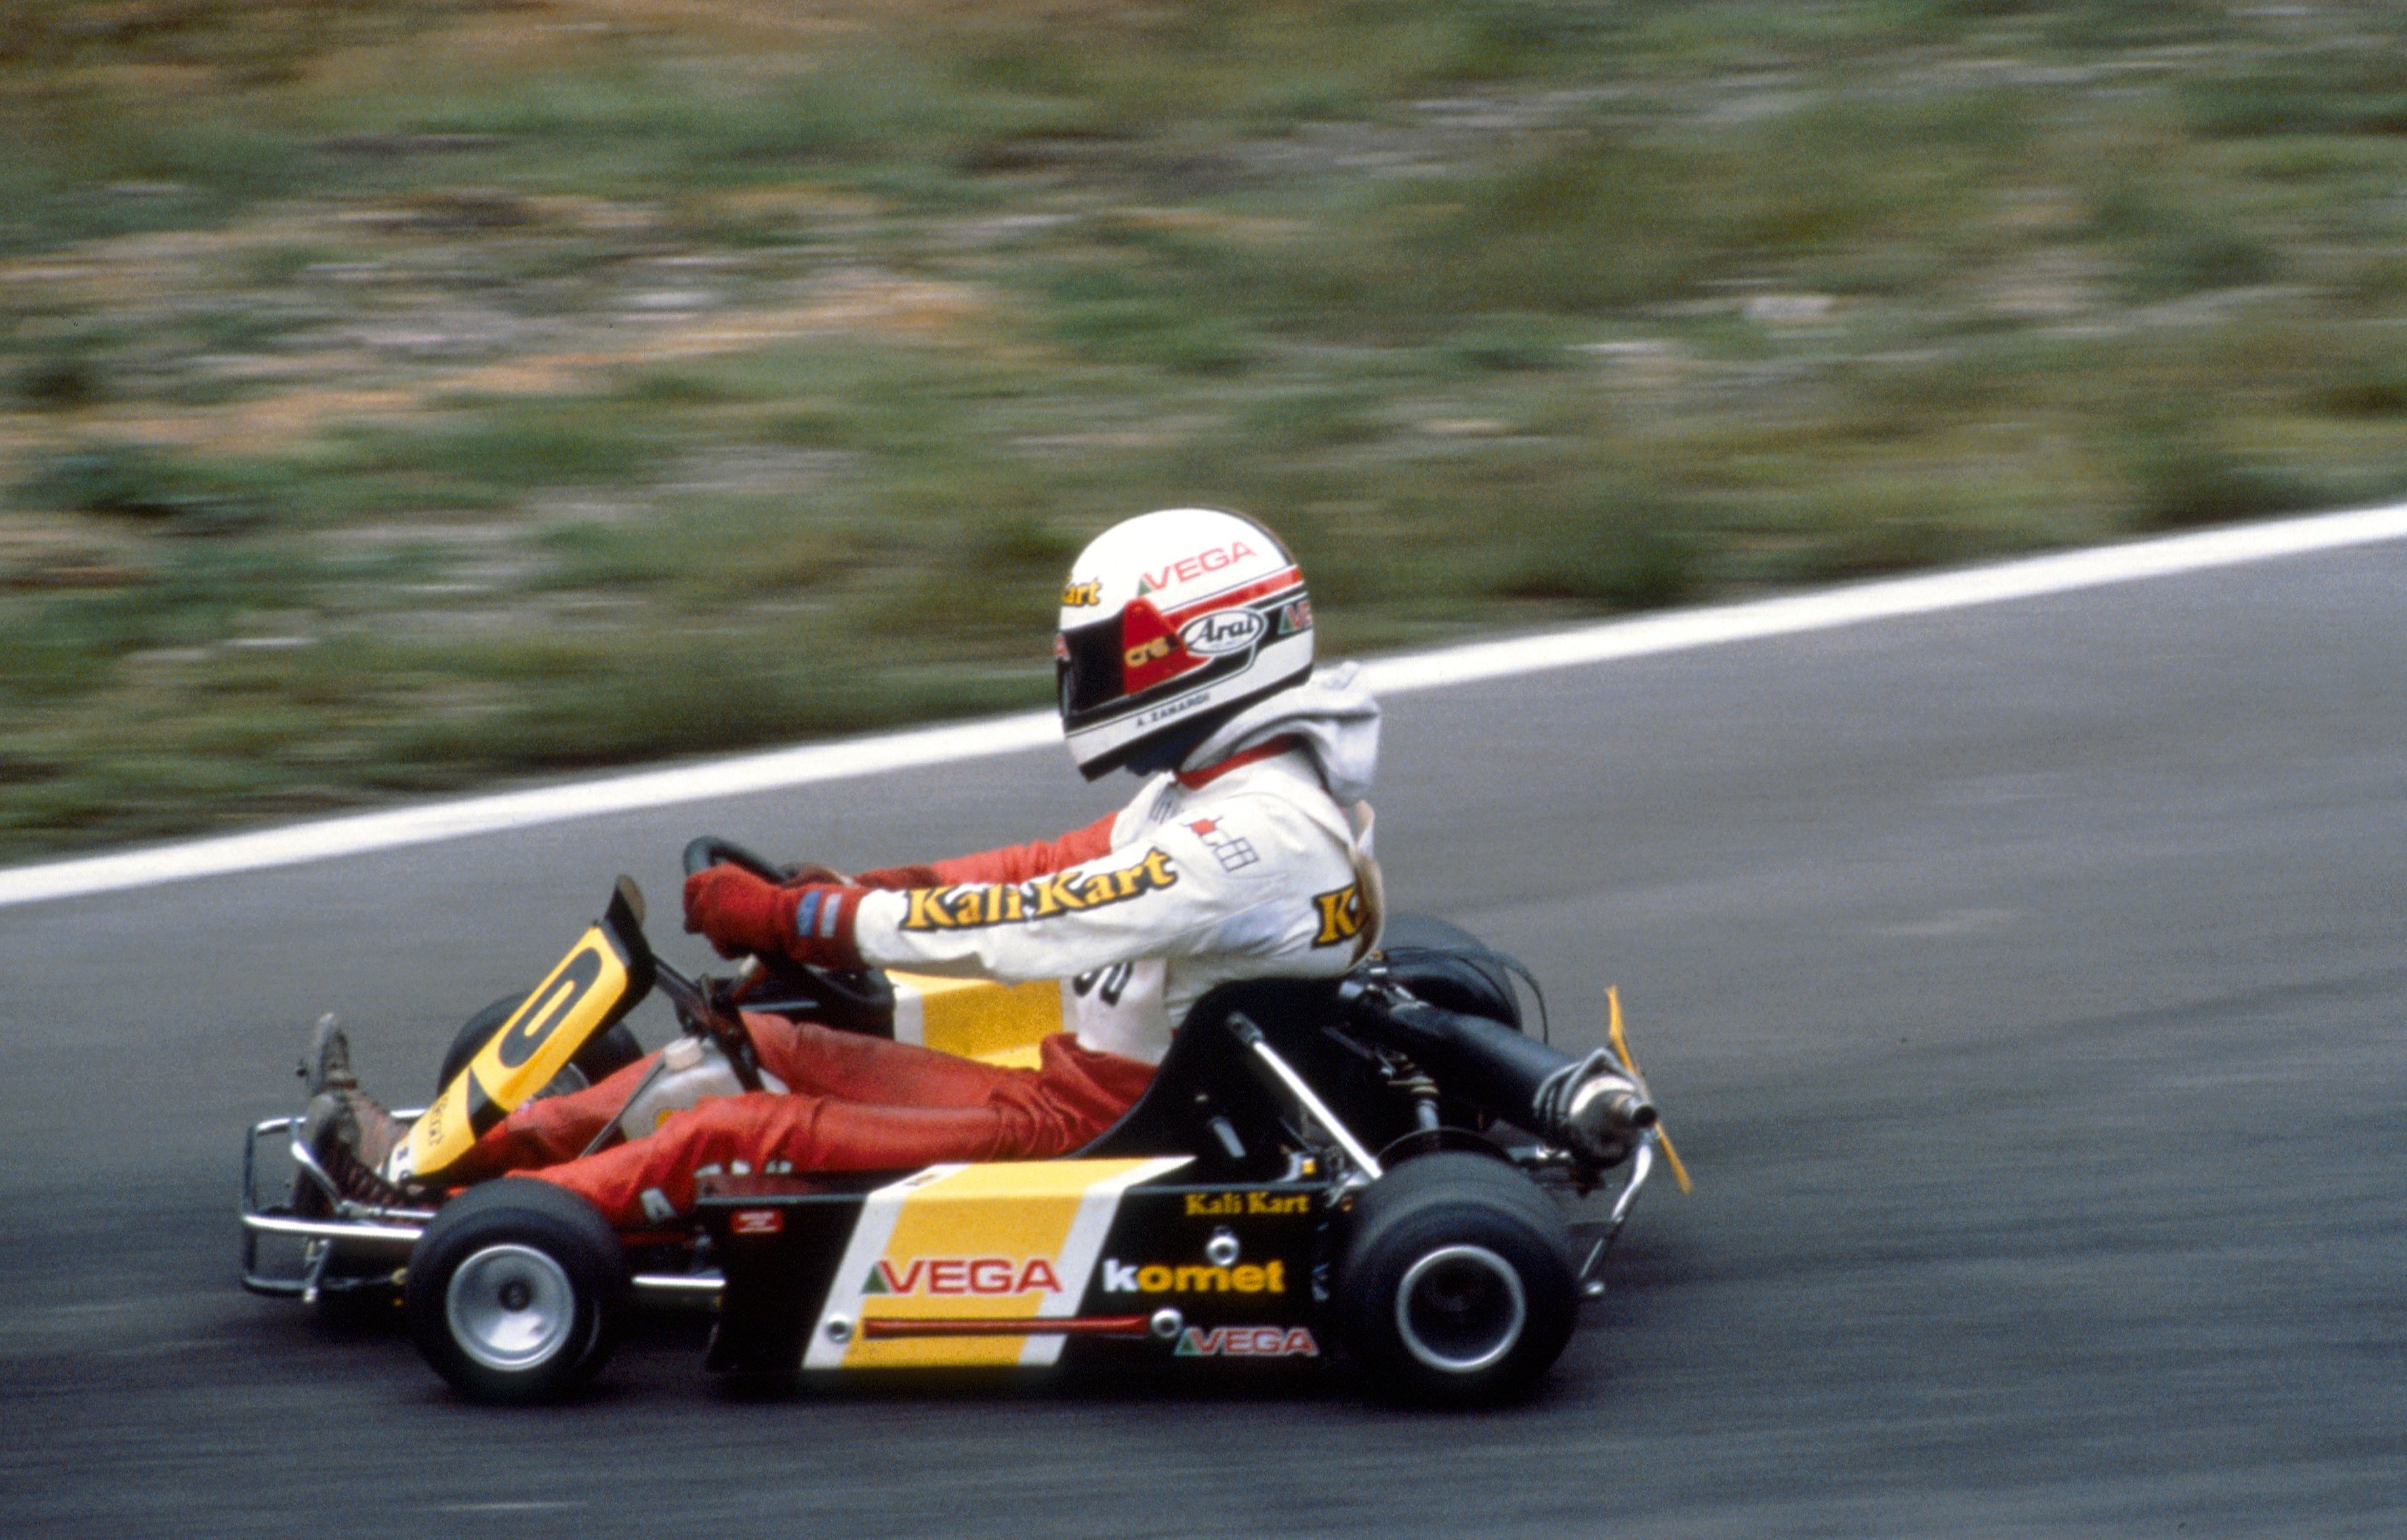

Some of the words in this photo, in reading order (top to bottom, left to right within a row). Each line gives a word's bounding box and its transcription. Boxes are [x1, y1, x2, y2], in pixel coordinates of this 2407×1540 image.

[1143, 540, 1256, 590] VEGA
[1061, 578, 1101, 606] art
[901, 881, 1027, 931] Kali
[1033, 849, 1178, 918] Kart
[1312, 883, 1362, 946] K
[499, 947, 602, 1068] 0
[1184, 1192, 1242, 1215] Kali
[1247, 1191, 1310, 1214] Kart
[878, 1259, 1063, 1295] VEGA
[1103, 1259, 1285, 1292] komet
[1190, 1327, 1319, 1356] VEGA
